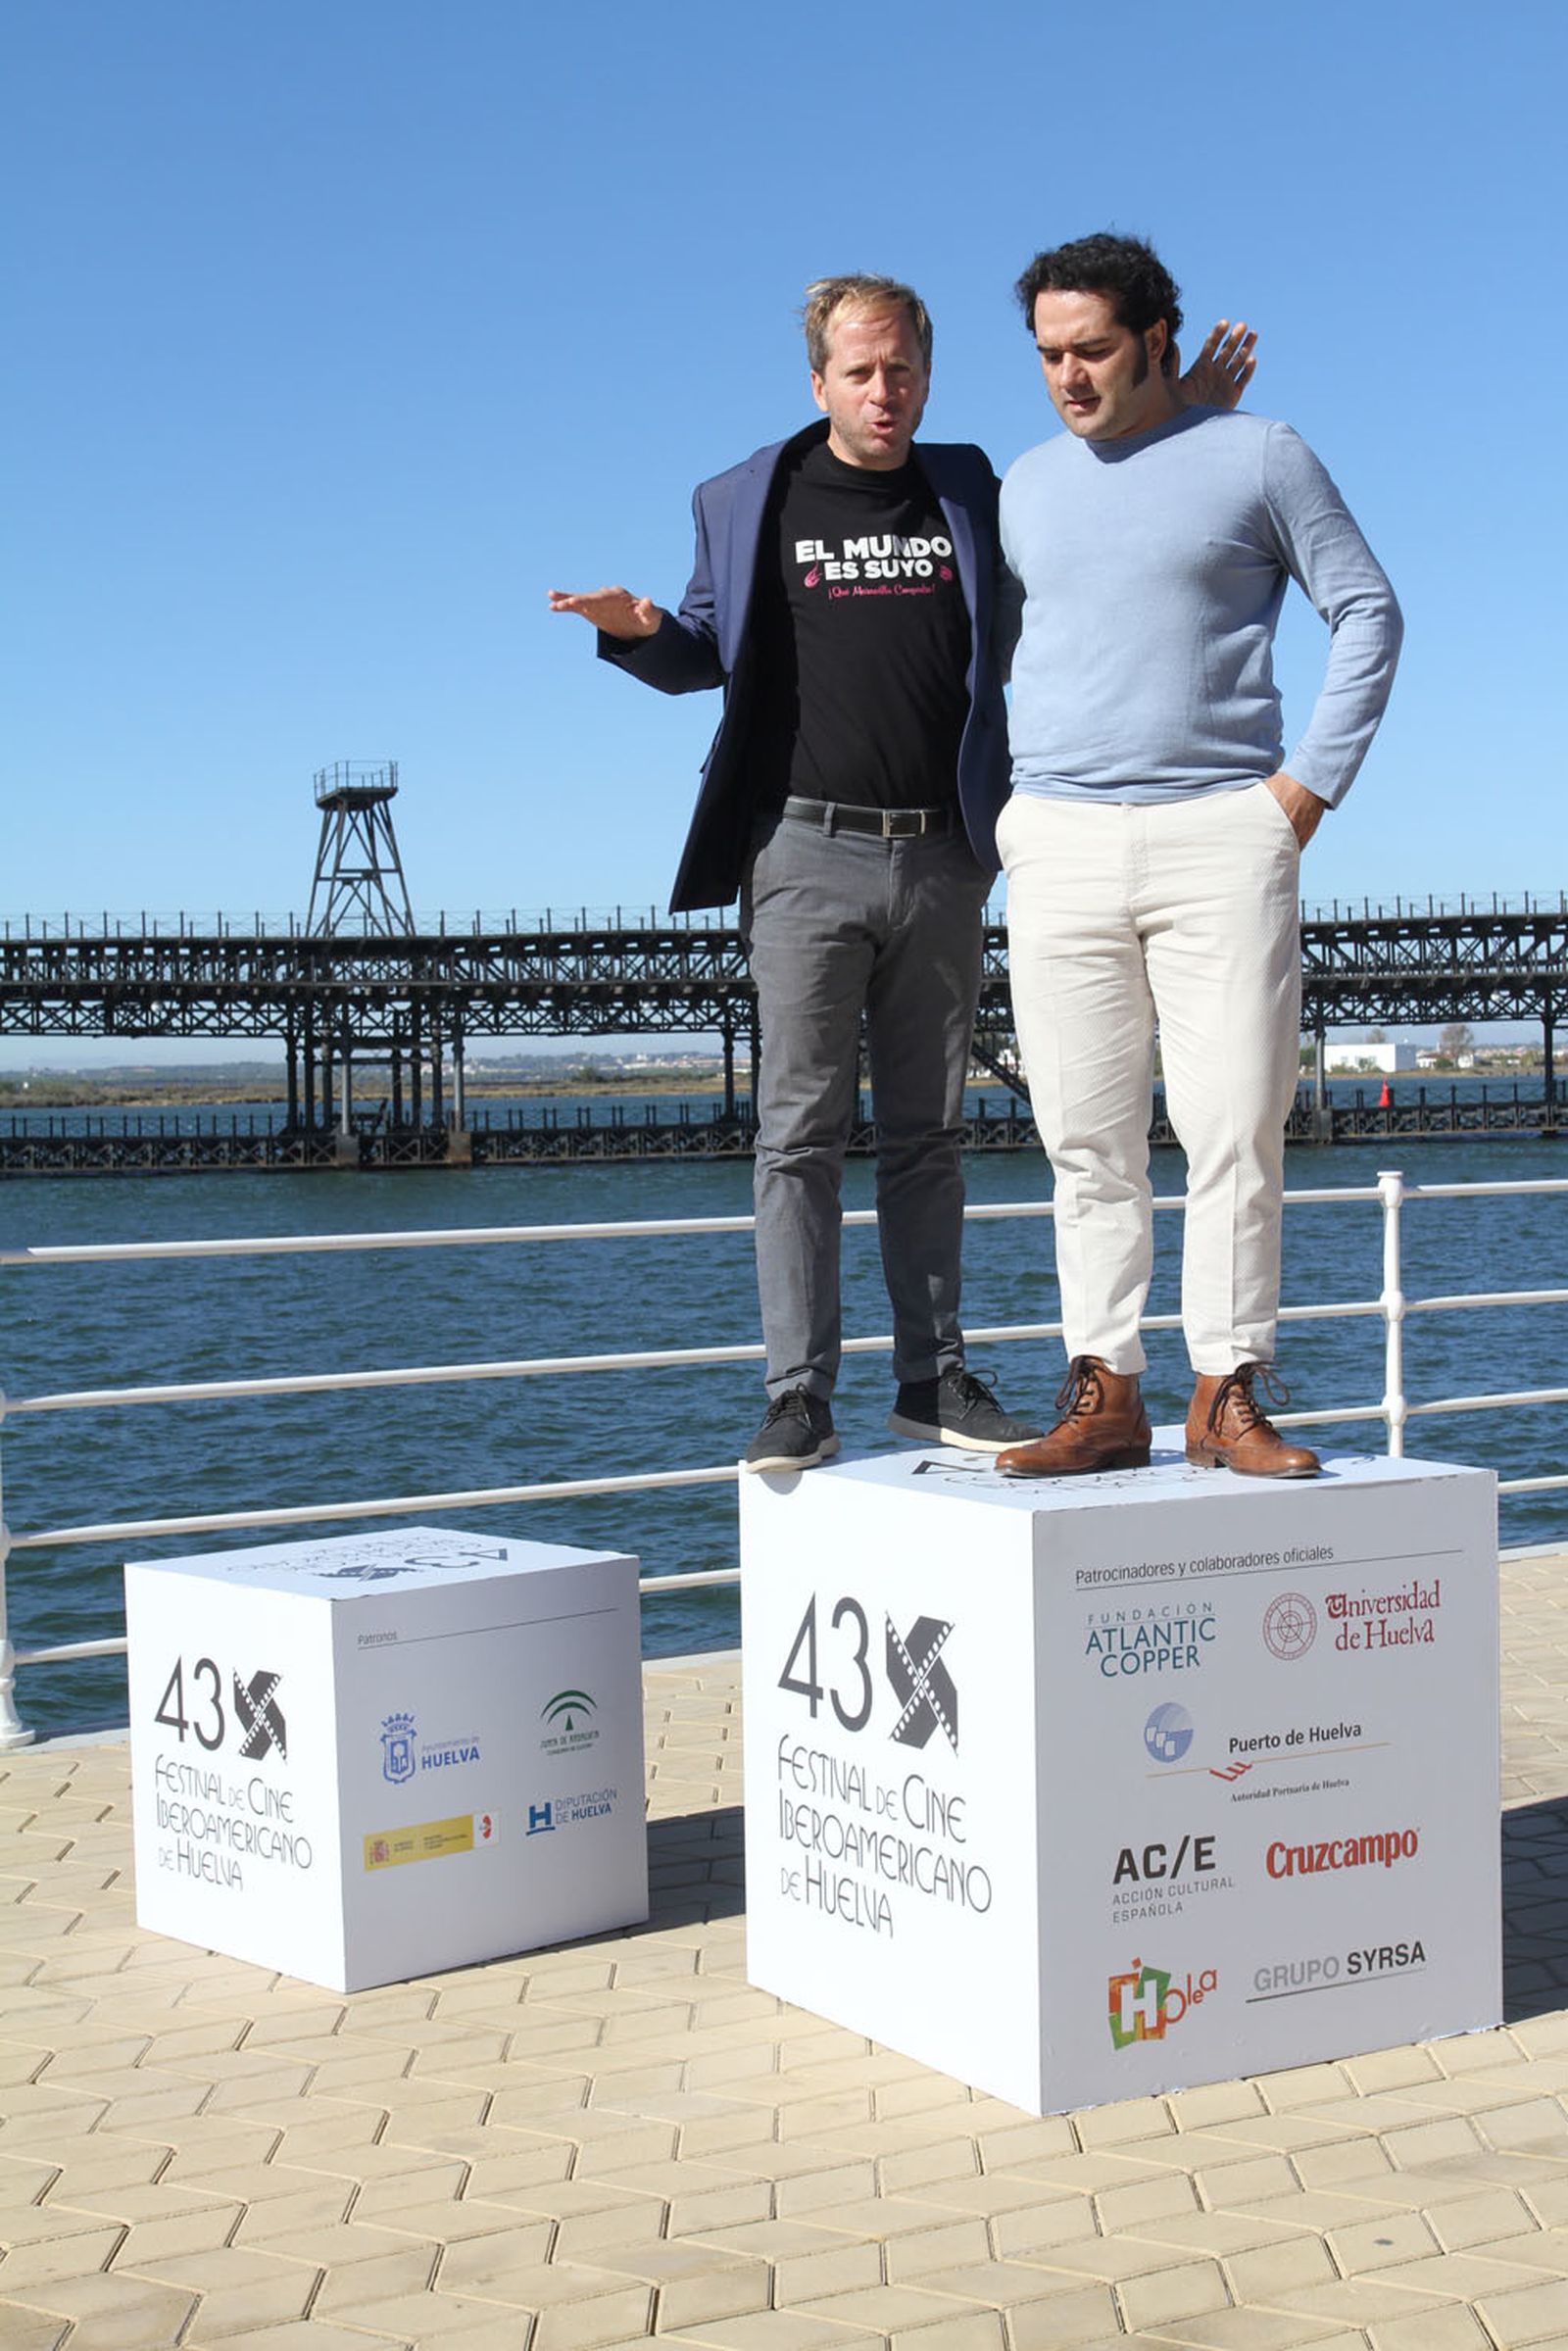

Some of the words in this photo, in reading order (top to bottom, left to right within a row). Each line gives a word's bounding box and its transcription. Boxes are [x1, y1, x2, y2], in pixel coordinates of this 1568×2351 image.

[796, 540, 834, 563] EL
[843, 535, 953, 560] MUNDO
[824, 561, 859, 580] ES
[864, 559, 933, 579] SUYO
[1076, 1560, 1175, 1585] Patrocinadores
[1178, 1562, 1185, 1577] y
[1189, 1550, 1280, 1573] colaboradores
[1283, 1545, 1334, 1563] oficiales
[1325, 1579, 1441, 1619] Universidad
[357, 1630, 397, 1644] Patronos
[1085, 1618, 1216, 1655] ATLANTIC
[1335, 1622, 1360, 1651] de
[1363, 1617, 1435, 1649] Huelva
[777, 1590, 872, 1733] 43
[1101, 1645, 1200, 1678] COPPER
[154, 1654, 225, 1751] 43
[1229, 1735, 1281, 1753] Puerto
[1286, 1729, 1304, 1745] de
[1309, 1722, 1361, 1742] Huelva
[421, 1746, 480, 1770] HUELVA
[155, 1754, 225, 1806] FESTIVAL
[247, 1777, 294, 1824] CINE
[777, 1734, 872, 1812] FESTIVAL
[903, 1774, 966, 1843] CINE
[1231, 1788, 1271, 1802] Autoridad
[1272, 1784, 1310, 1797] Portuaria
[1311, 1782, 1320, 1791] de
[1322, 1779, 1349, 1789] Huelva
[156, 1792, 313, 1869] IBEROAMERICANO
[556, 1810, 569, 1824] DE
[571, 1802, 612, 1821] HUELVA
[177, 1837, 243, 1891] HUELVA
[779, 1788, 992, 1913] IBEROAMERICANO
[1112, 1835, 1216, 1885] AC/E
[1266, 1829, 1418, 1879] Cruzcampo
[805, 1854, 894, 1939] HUELVA
[1167, 1877, 1235, 1897] CULTURAL
[1112, 1901, 1183, 1923] ESPAÑOLA
[1253, 1956, 1340, 1992] GRUPO
[1347, 1940, 1426, 1976] SYRSA
